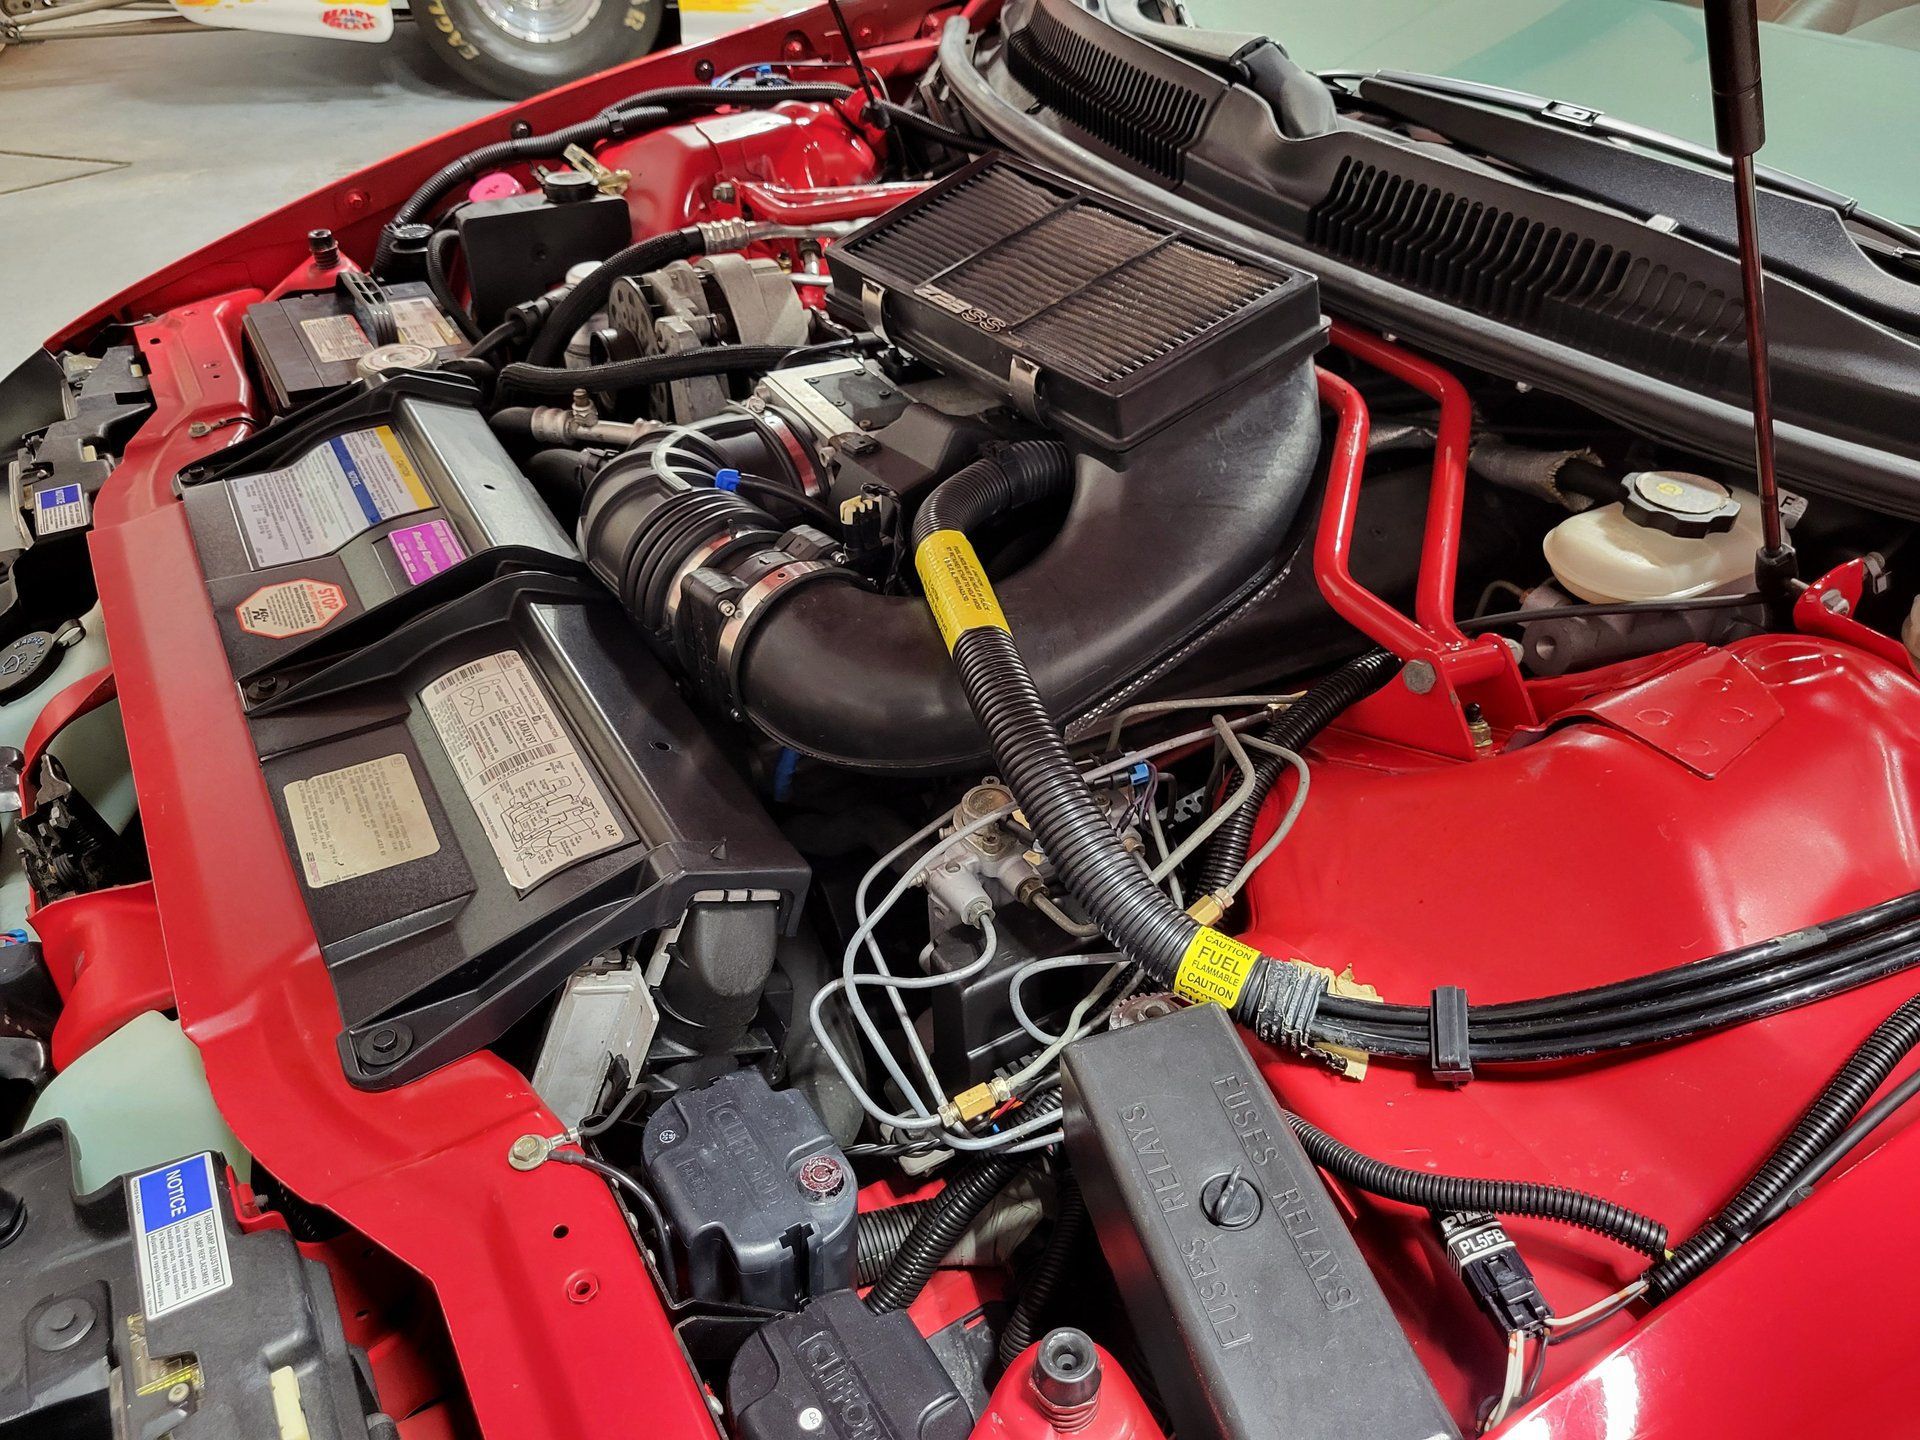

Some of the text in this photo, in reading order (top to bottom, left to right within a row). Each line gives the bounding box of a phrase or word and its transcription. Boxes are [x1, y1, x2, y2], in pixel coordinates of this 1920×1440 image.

[317, 588, 338, 609] STOP
[515, 718, 537, 745] CATALYST
[604, 824, 617, 837] CAF
[1198, 945, 1241, 977] FUEL
[1205, 935, 1252, 961] CAUTION
[1186, 972, 1234, 1001] CAUTION
[1191, 959, 1240, 987] FLAMMABLE
[165, 1168, 186, 1217] NOTICE
[1213, 1074, 1353, 1308] FUSES RELAYS
[1121, 1102, 1253, 1349] FUSES RELAYS
[193, 1220, 209, 1287] HEADLAMP REPLACEMENT
[203, 1214, 221, 1284] HEADLAMP ADJUSTMENT
[1458, 1228, 1507, 1256] PL5FB
